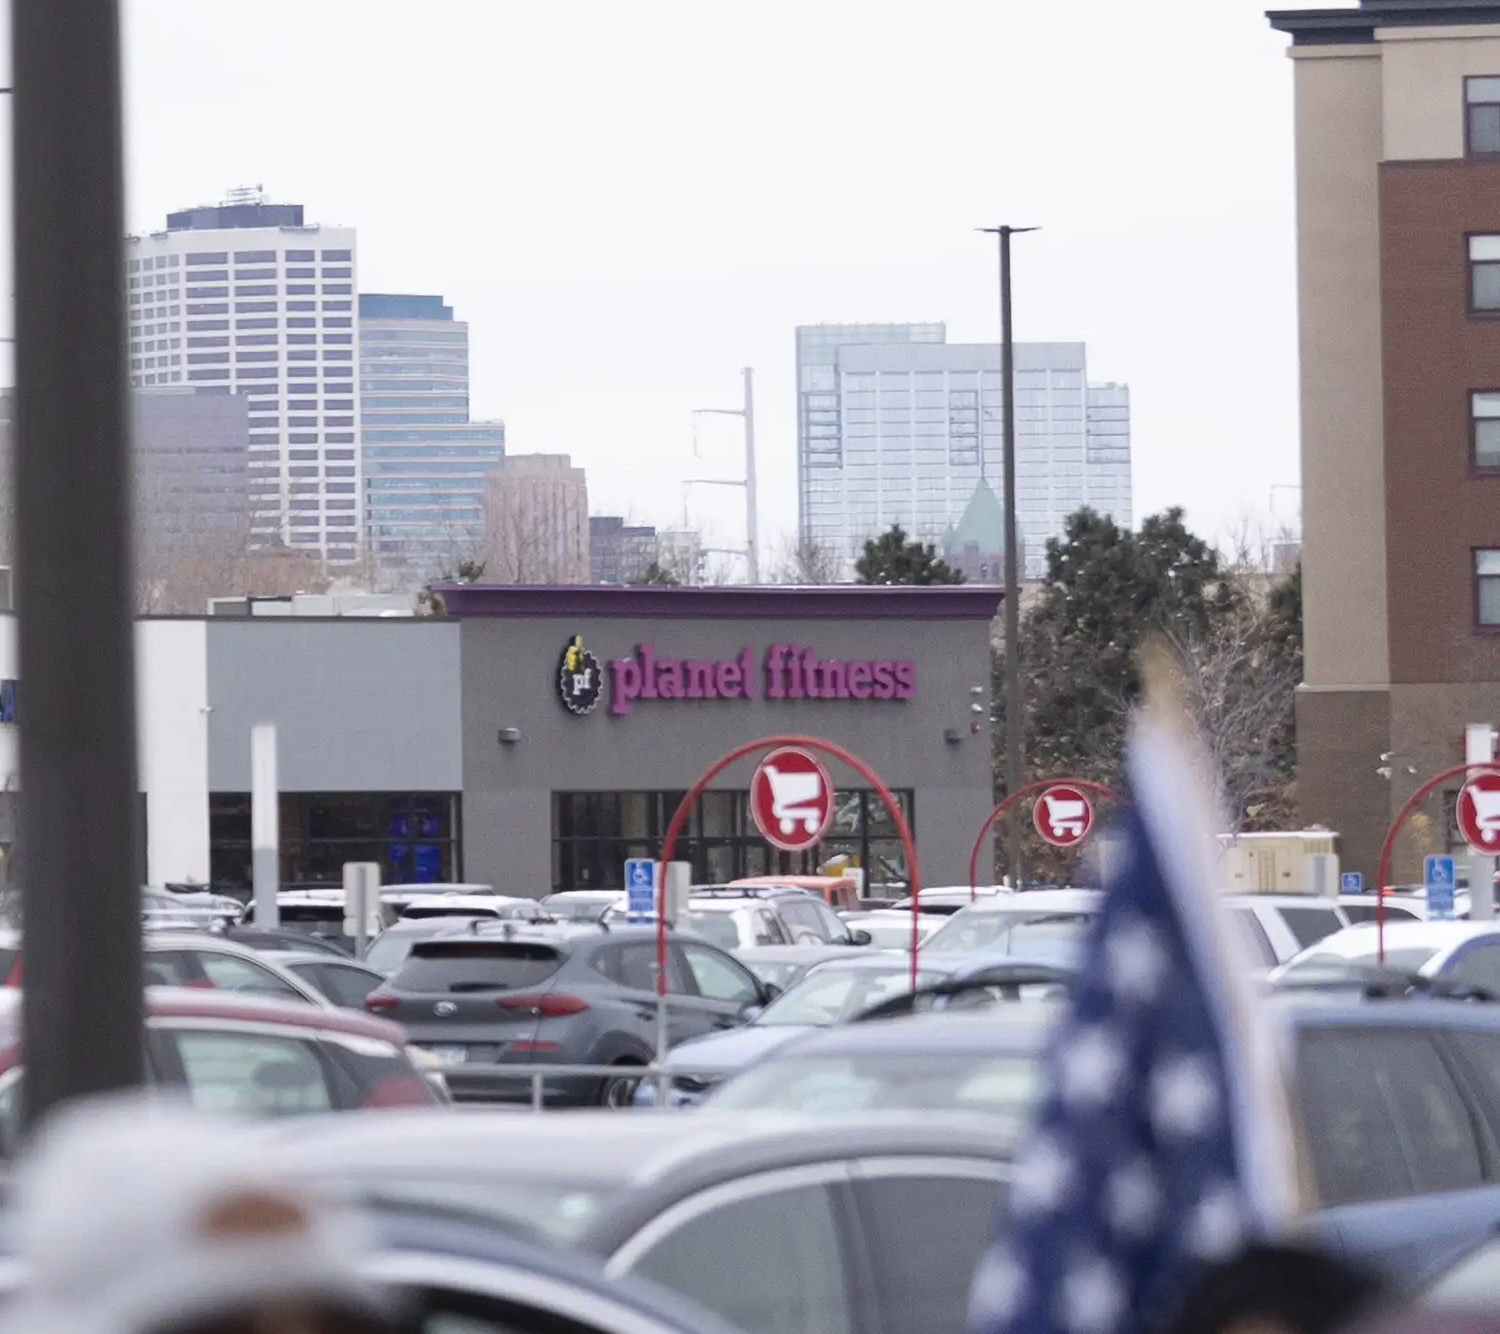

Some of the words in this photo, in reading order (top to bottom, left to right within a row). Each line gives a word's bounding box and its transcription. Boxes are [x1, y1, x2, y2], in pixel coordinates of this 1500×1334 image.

[572, 667, 592, 695] pf
[610, 643, 756, 715] planet
[766, 643, 916, 699] fitness
